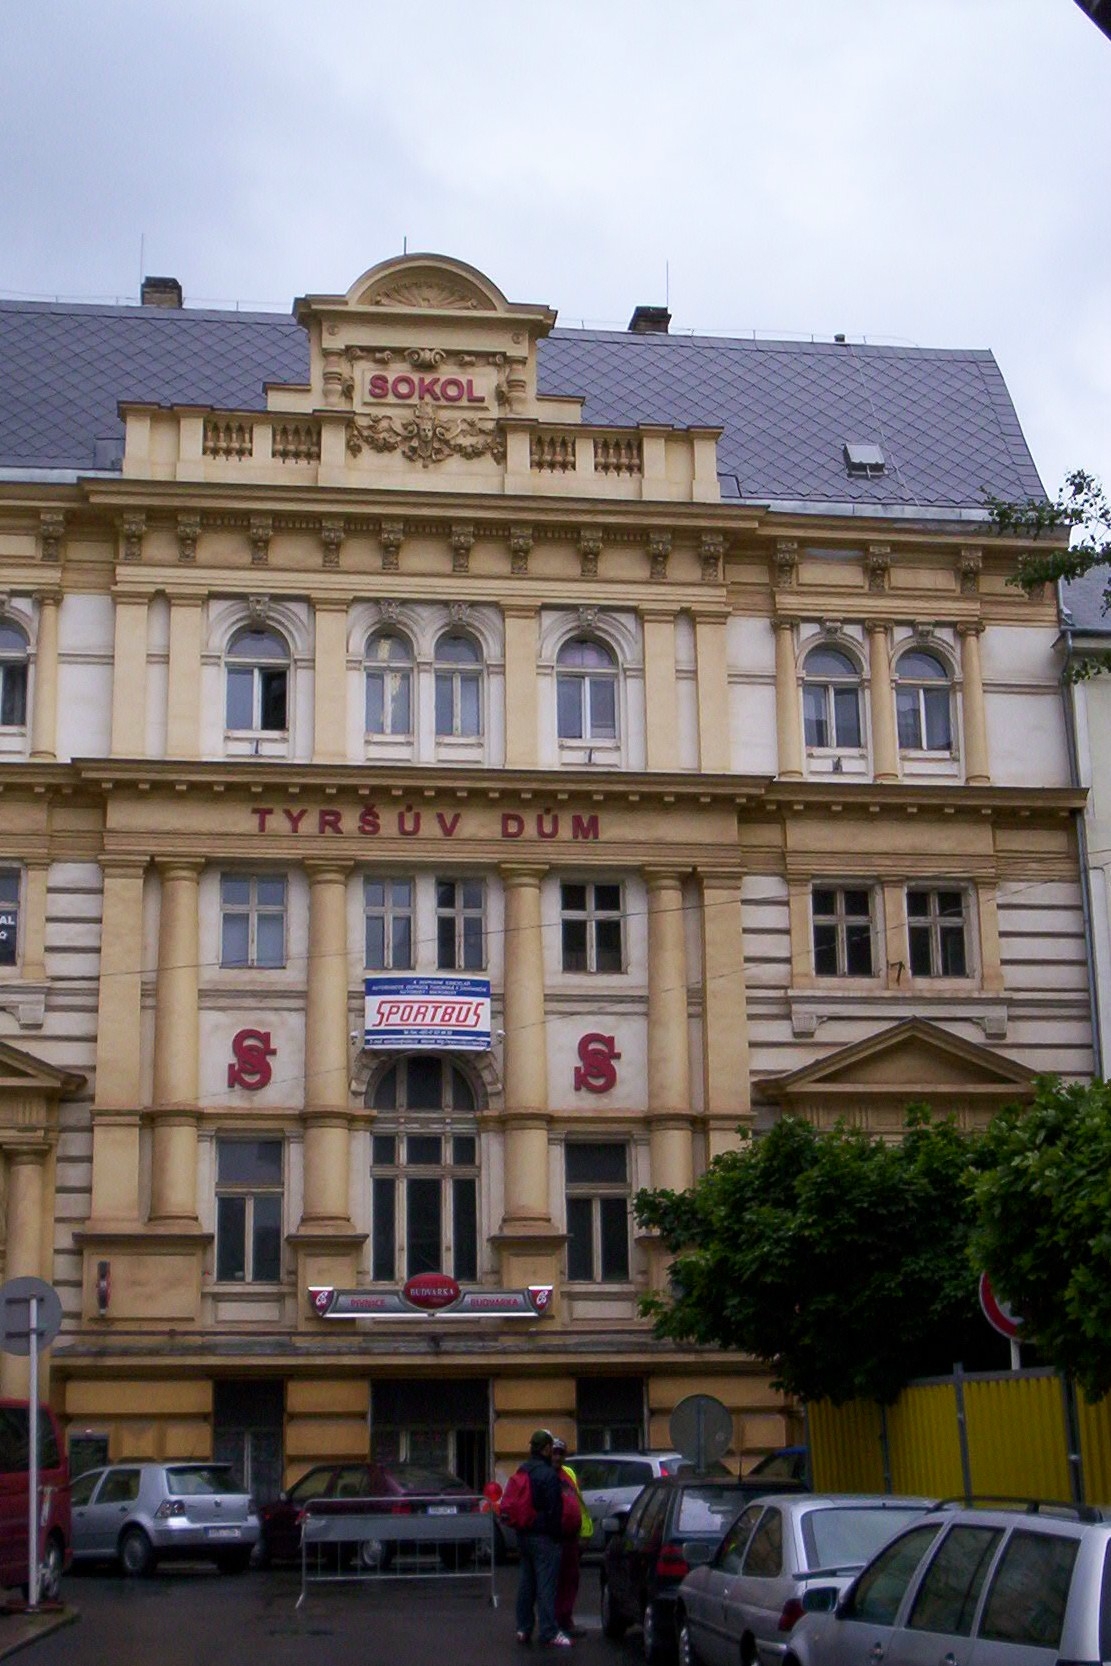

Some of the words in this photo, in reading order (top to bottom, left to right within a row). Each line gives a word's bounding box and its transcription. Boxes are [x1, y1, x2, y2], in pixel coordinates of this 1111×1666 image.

[368, 373, 486, 403] SOKOL
[251, 803, 462, 838] TYRŠŮV
[501, 806, 600, 840] DŮM
[372, 1000, 484, 1028] SPORTBUS
[409, 1288, 455, 1297] BUDVARKA
